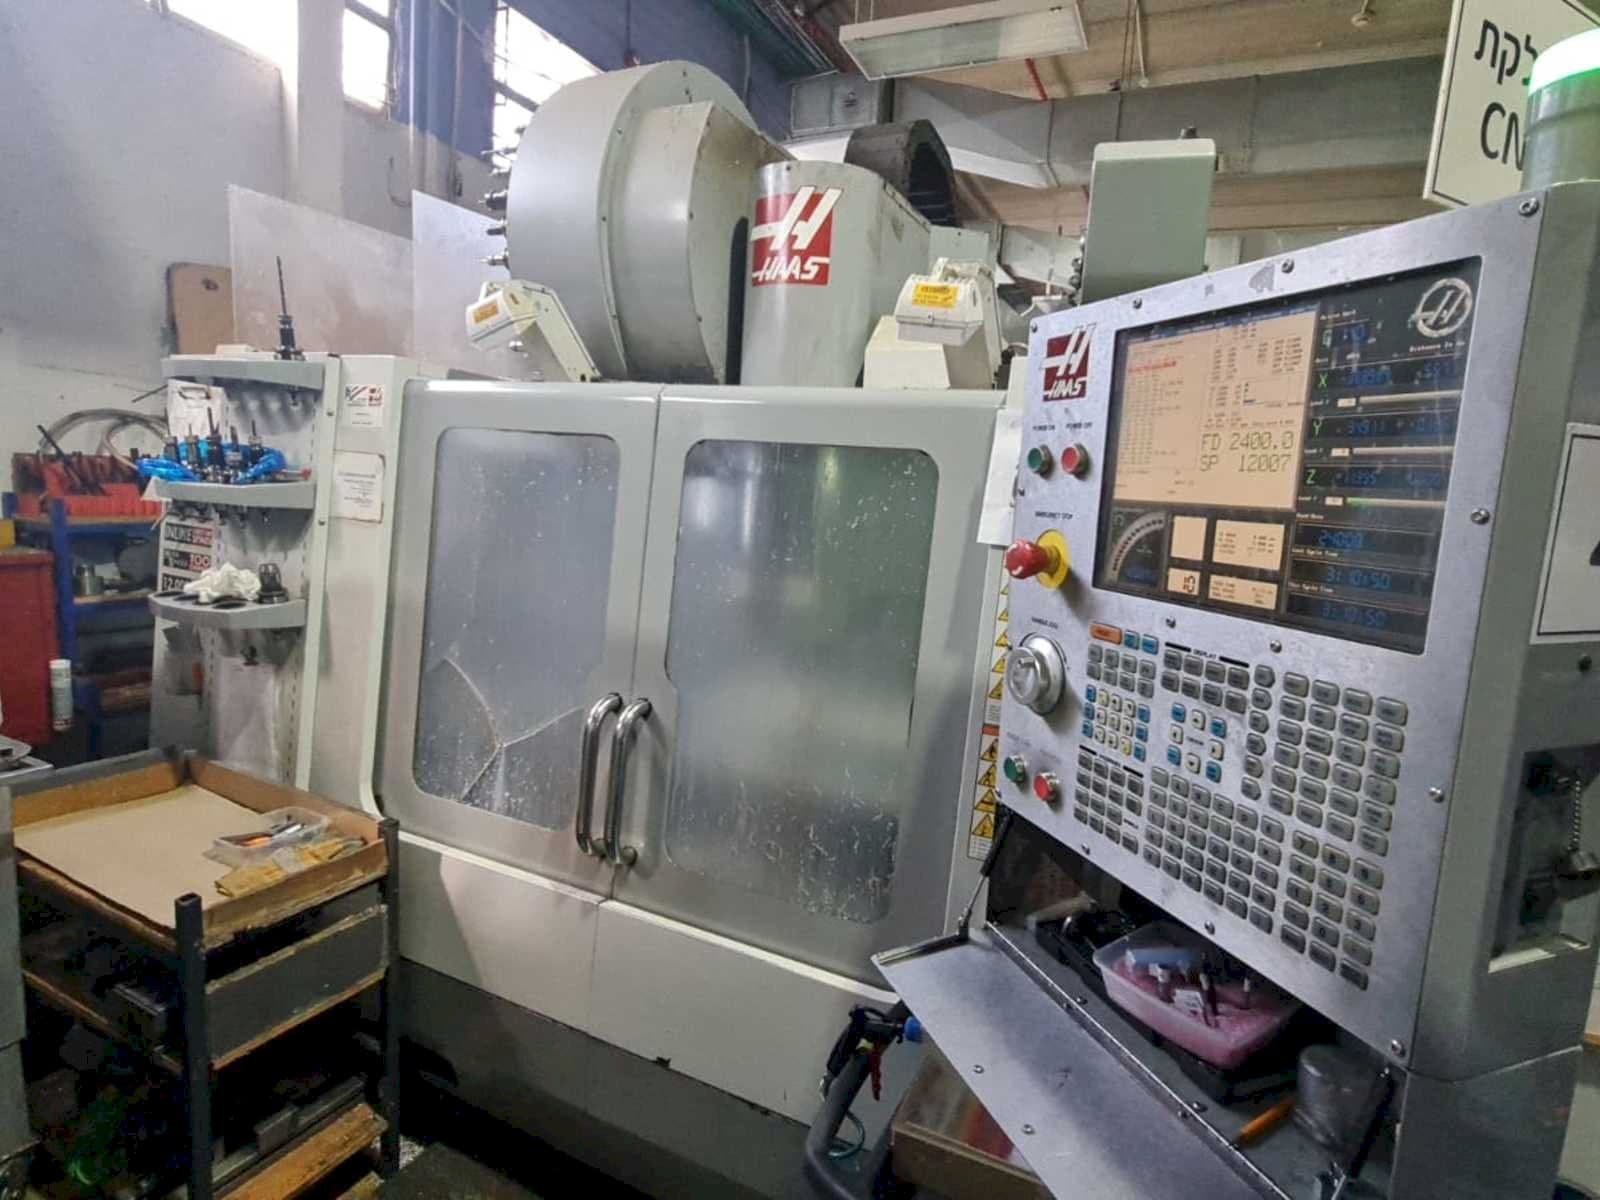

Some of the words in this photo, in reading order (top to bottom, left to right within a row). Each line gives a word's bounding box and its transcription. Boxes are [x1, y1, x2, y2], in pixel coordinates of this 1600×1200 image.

[1474, 19, 1538, 86] לקת
[1480, 102, 1527, 171] CN
[752, 255, 830, 282] HAAS
[1043, 377, 1088, 399] HAAS
[1319, 373, 1328, 388] X
[1313, 418, 1323, 436] Y
[1201, 432, 1221, 450] FD
[1200, 454, 1218, 472] SP
[1306, 469, 1317, 484] Z
